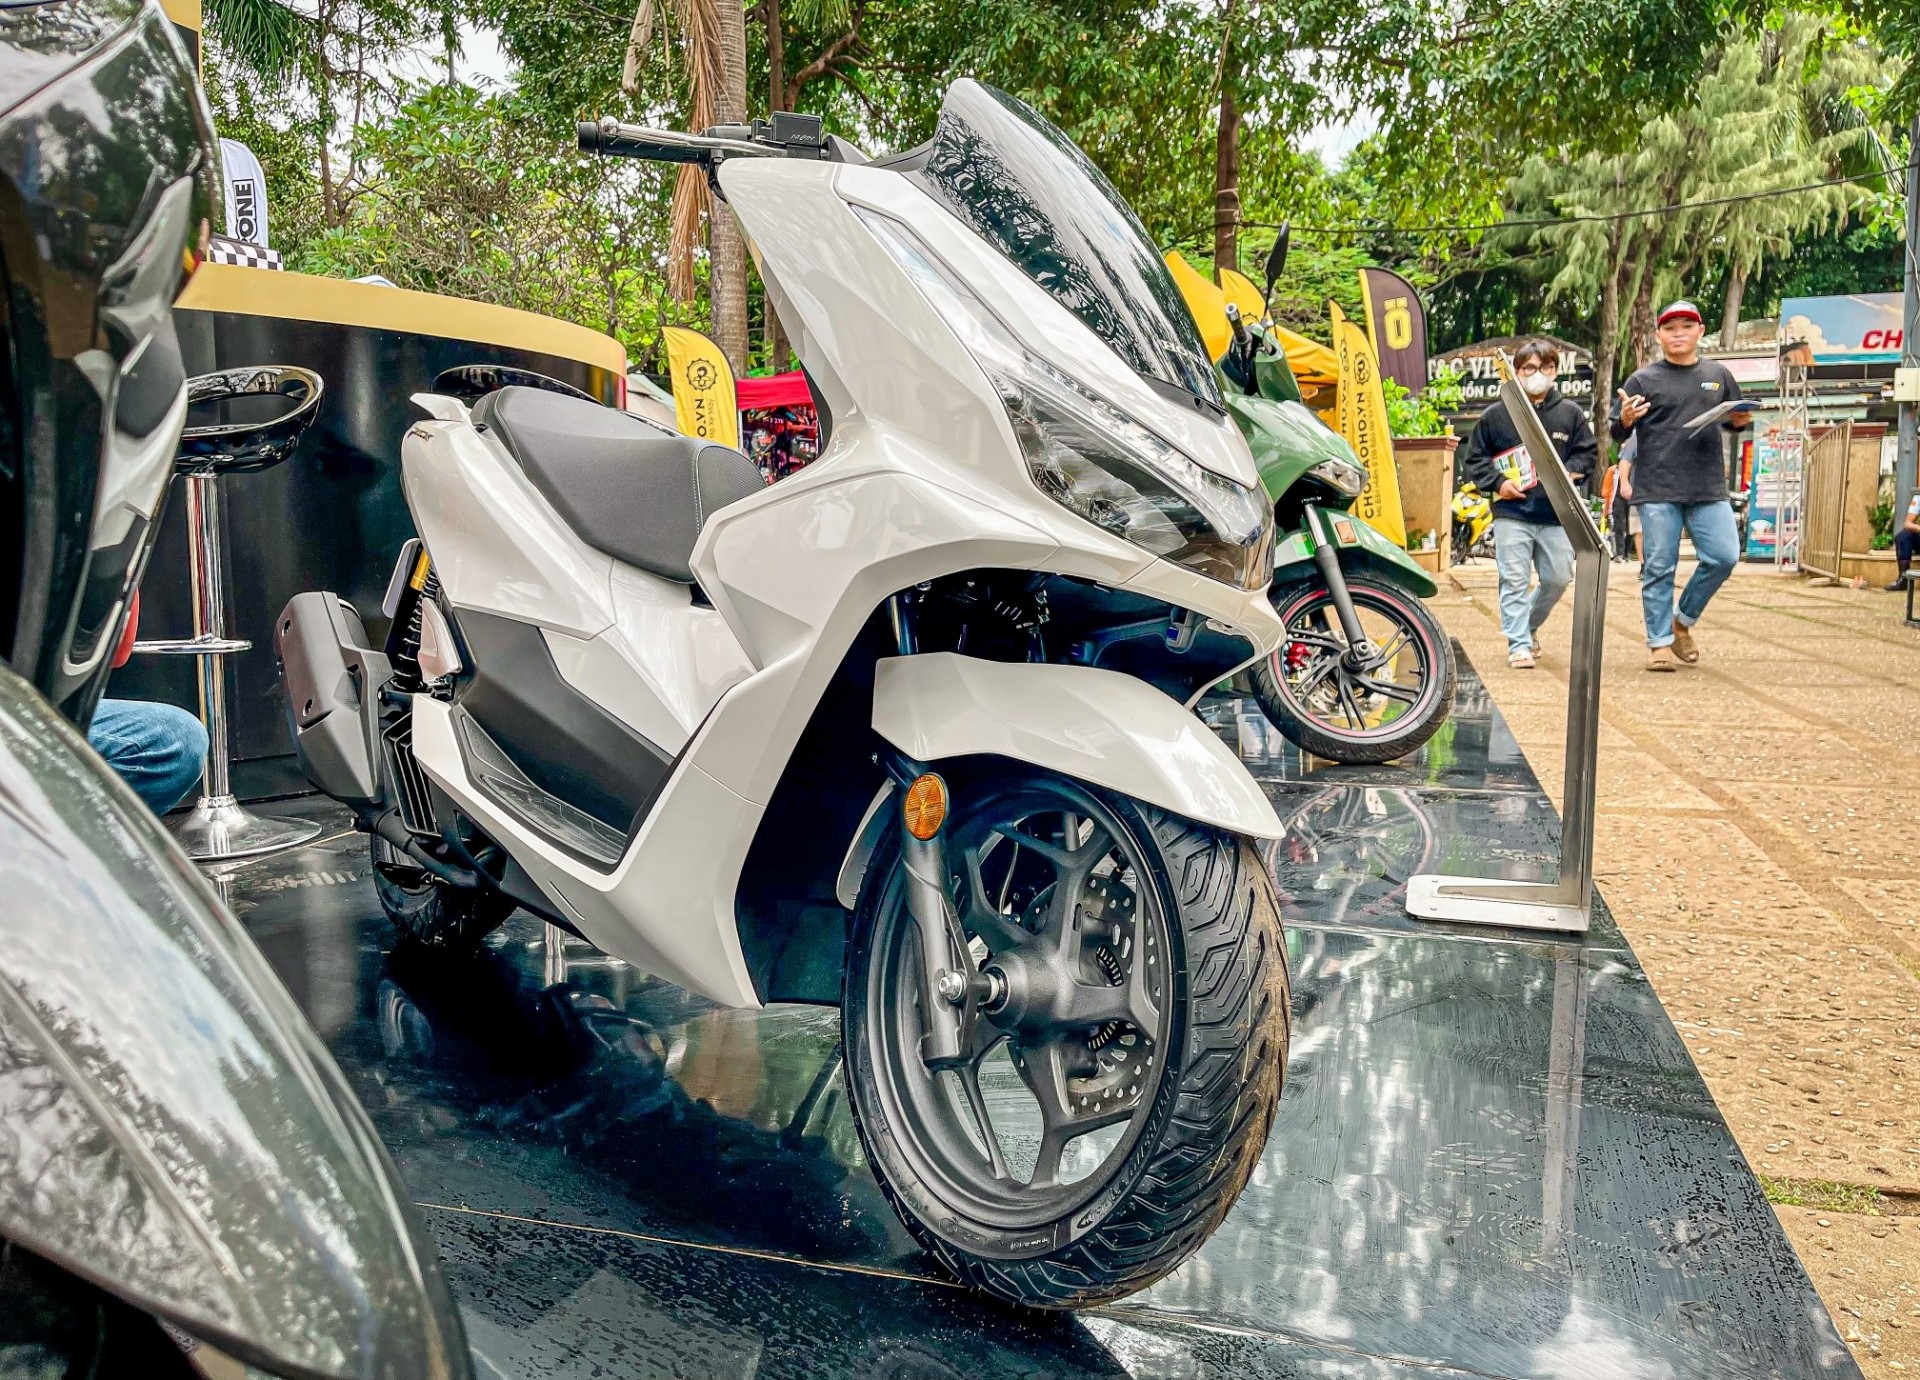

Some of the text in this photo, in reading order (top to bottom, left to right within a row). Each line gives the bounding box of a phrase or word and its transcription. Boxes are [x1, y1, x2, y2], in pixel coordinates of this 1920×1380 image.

[234, 182, 256, 241] ONE
[1862, 328, 1904, 351] CH
[694, 398, 707, 437] O.VN
[1356, 392, 1375, 519] CHOAOHO.VN
